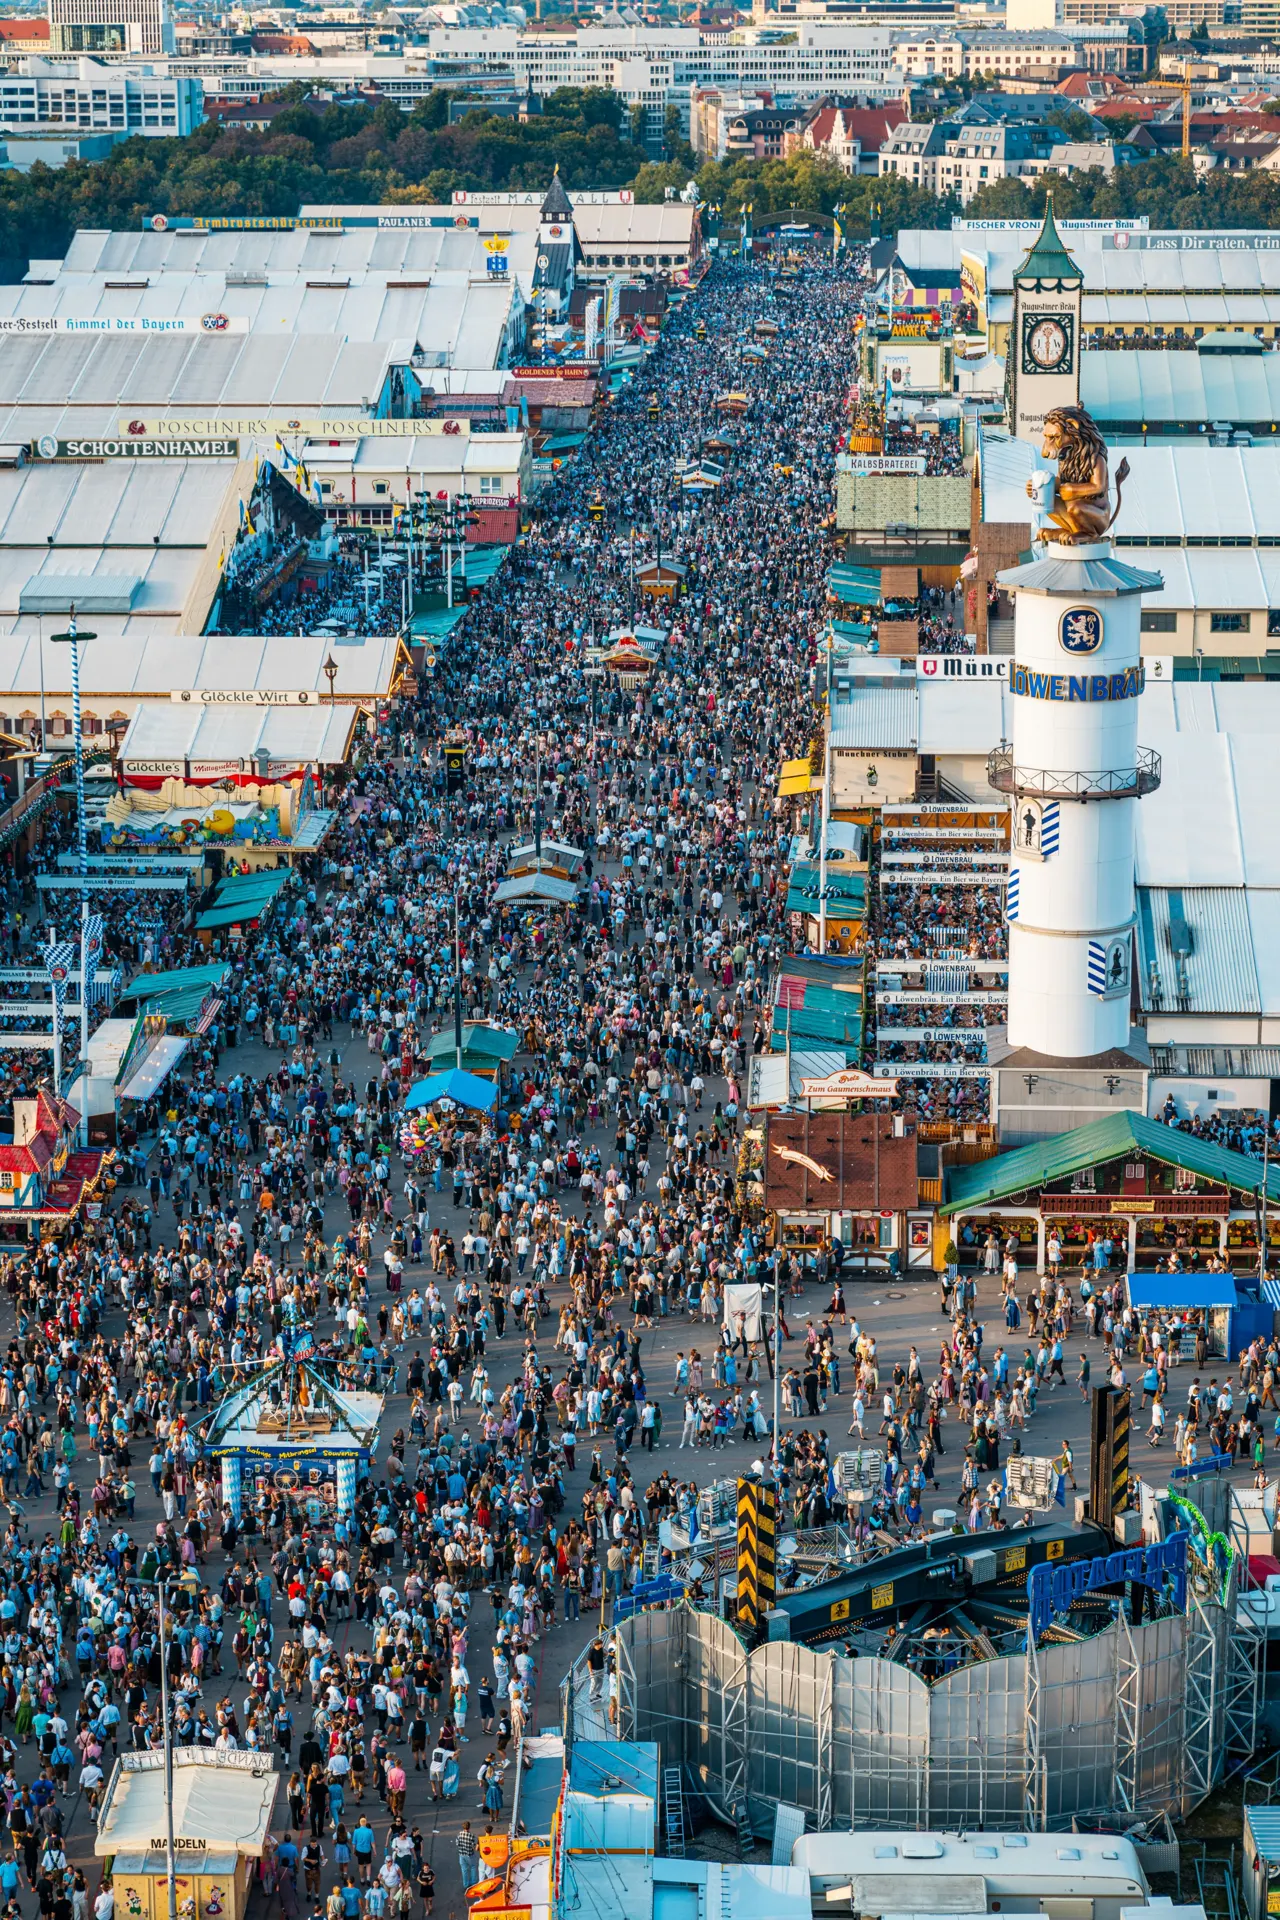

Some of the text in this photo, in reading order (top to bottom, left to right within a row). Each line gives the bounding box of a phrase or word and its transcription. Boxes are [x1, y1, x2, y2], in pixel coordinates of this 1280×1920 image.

[508, 194, 608, 204] MARALL
[193, 217, 343, 228] Armbrustschützenzelt
[378, 217, 432, 227] PAULANER
[967, 221, 1041, 229] FISCHER VRONI
[1060, 220, 1135, 230] Augustiner Bräu
[1146, 236, 1178, 249] Lass
[1182, 236, 1206, 249] Dir
[1209, 238, 1250, 250] raten,
[1021, 302, 1076, 311] Augustiner Bräu
[66, 318, 111, 330] Himmel
[116, 318, 135, 330] der
[141, 318, 185, 331] Bayern
[891, 324, 927, 337] AMMER
[158, 420, 268, 434] POSCHNER'S
[322, 420, 433, 434] POSCHNER'S
[66, 441, 234, 457] SCHOTTENHAMEL
[424, 577, 464, 586] SCHOTTENAMEL
[1009, 658, 1146, 702] LÖWENBRÄU
[201, 691, 288, 702] Glöckle Wirt
[126, 762, 180, 772] Glöckle's
[897, 830, 934, 838] Löwenbräu.
[975, 831, 999, 839] Bayern.
[931, 855, 973, 863] LÖWENBRÄU
[981, 876, 1006, 884] Bayern.
[929, 963, 976, 972] LÖWENBRÄU
[895, 995, 939, 1003] Löwenbräu.
[941, 995, 953, 1003] Ein
[955, 995, 970, 1003] Bier
[933, 1031, 983, 1041] LÖWENBRÄU
[894, 1068, 941, 1076] Löwenbräu.
[943, 1068, 957, 1076] Ein
[959, 1068, 976, 1076] Bier
[807, 1085, 892, 1093] Zum Gaumenschmaus
[151, 1838, 206, 1849] MANDELN
